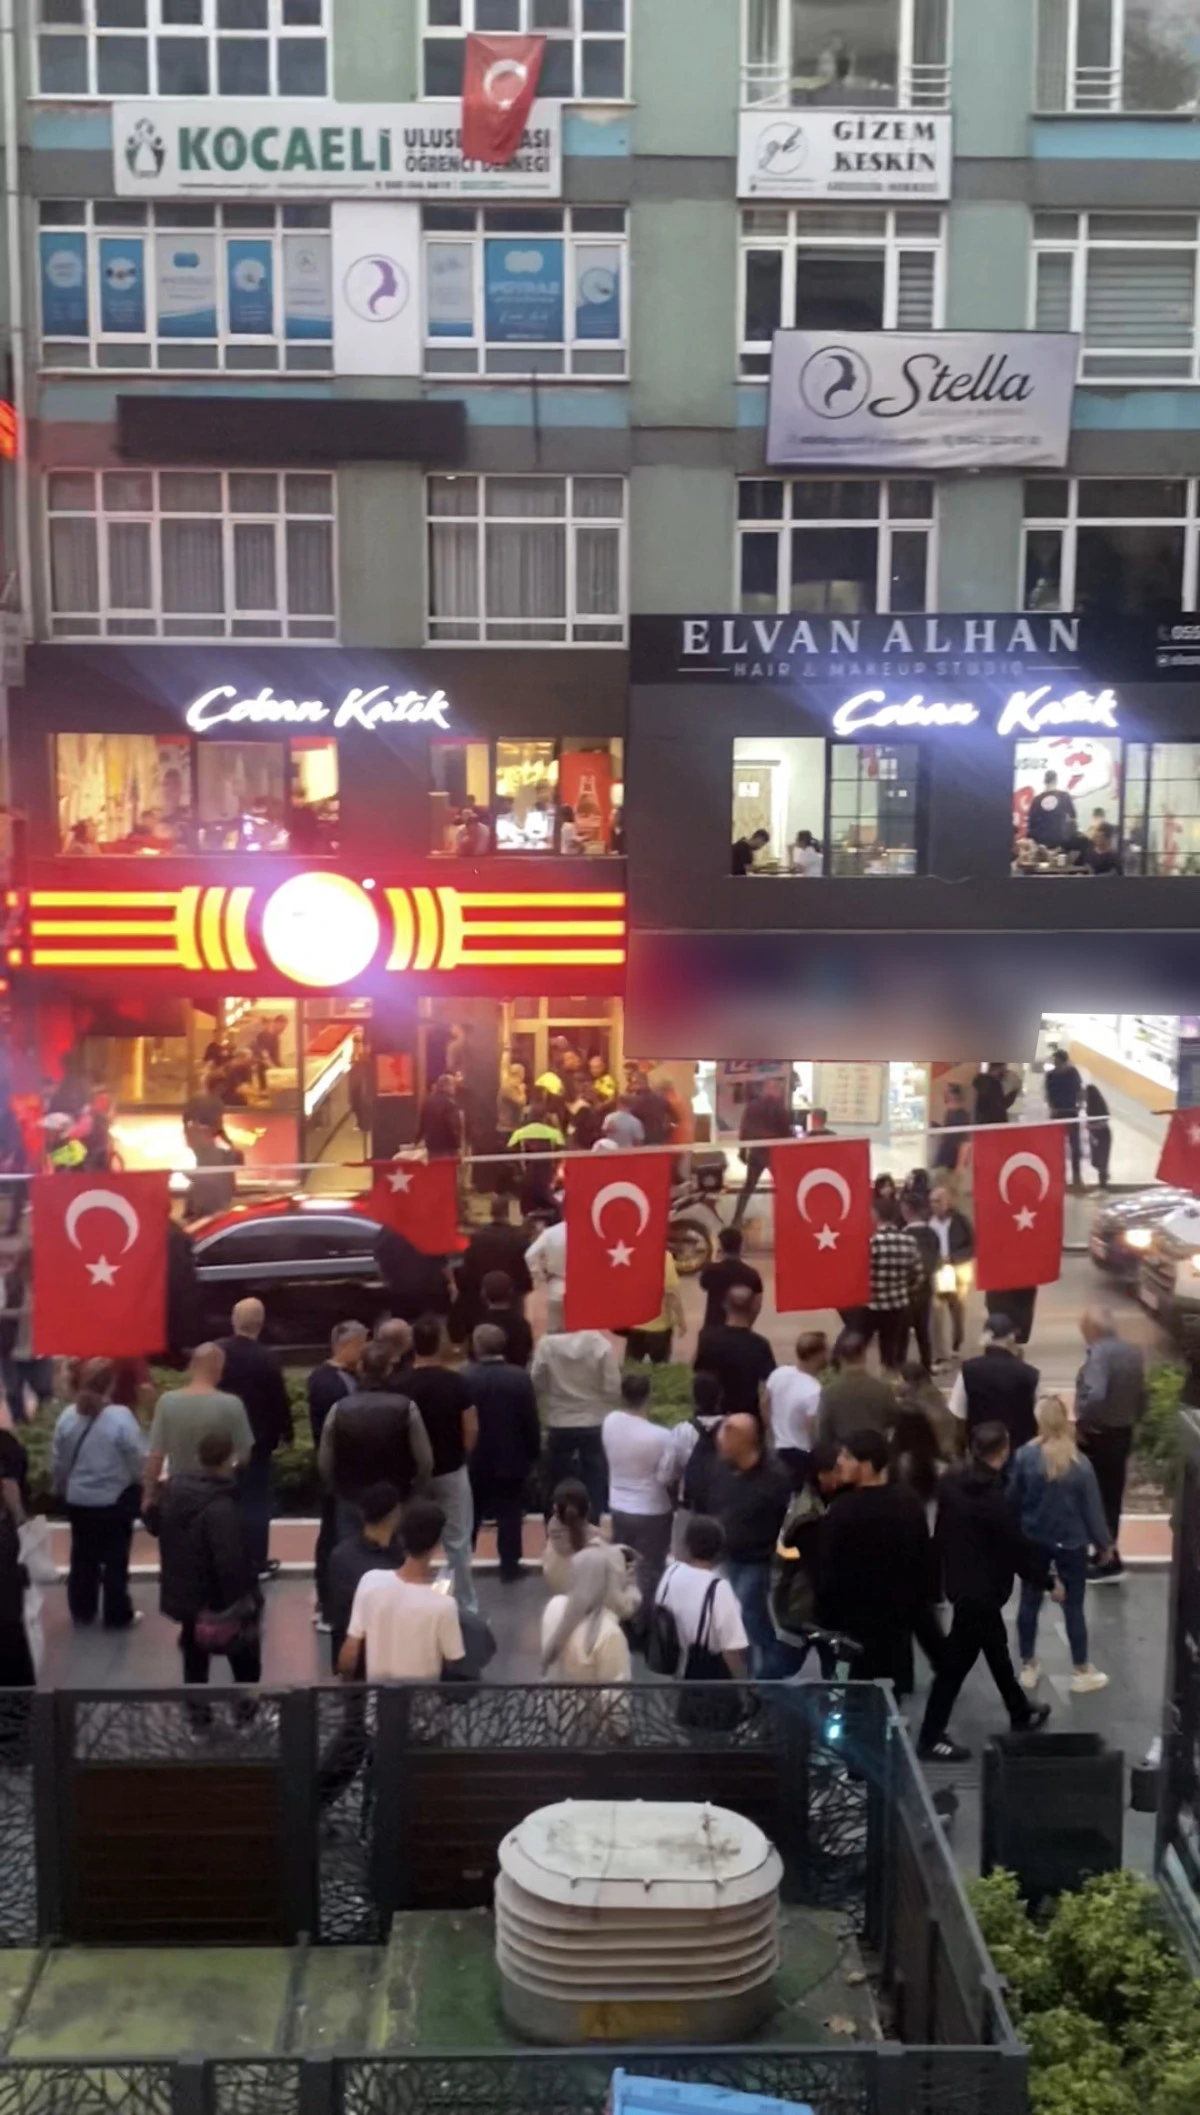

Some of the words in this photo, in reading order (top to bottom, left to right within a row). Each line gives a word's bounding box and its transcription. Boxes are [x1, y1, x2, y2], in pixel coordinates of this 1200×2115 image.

[833, 117, 936, 141] GİZEM
[178, 126, 392, 172] KOCAELİ
[832, 148, 936, 172] KESKİN
[867, 353, 1035, 418] Stella
[682, 619, 861, 655] ELVAN
[882, 618, 1080, 654] ALHAN
[734, 661, 790, 677] HAIR
